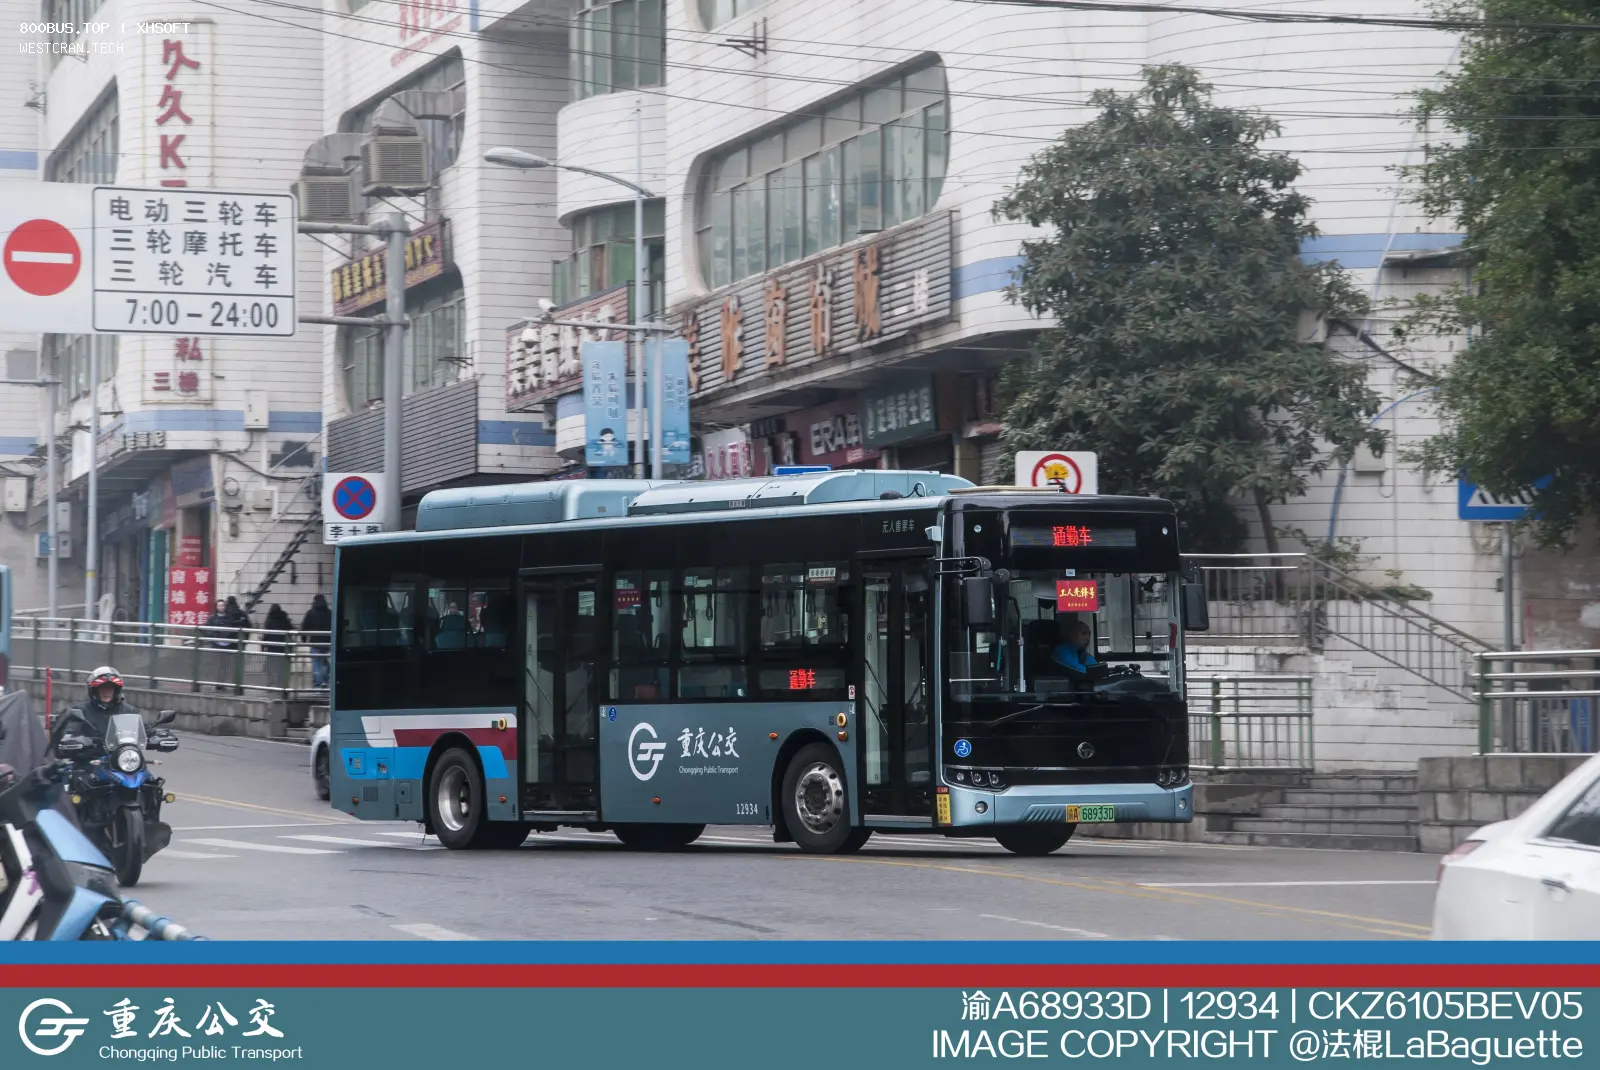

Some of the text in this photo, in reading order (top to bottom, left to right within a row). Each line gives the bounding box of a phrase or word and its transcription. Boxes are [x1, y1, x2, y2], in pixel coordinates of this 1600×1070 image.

[156, 39, 200, 187] 久久K
[110, 196, 277, 227] 电动三轮车
[110, 229, 277, 258] 三轮摩托车
[110, 260, 278, 289] 三轮汽车
[1052, 525, 1093, 547] 通勤车
[1060, 586, 1095, 600] 工人先锋号
[789, 668, 816, 689] 通勤车
[677, 726, 740, 758] 重庆公交
[679, 765, 739, 776] Chongqing Public Transport
[736, 803, 758, 815] 12934
